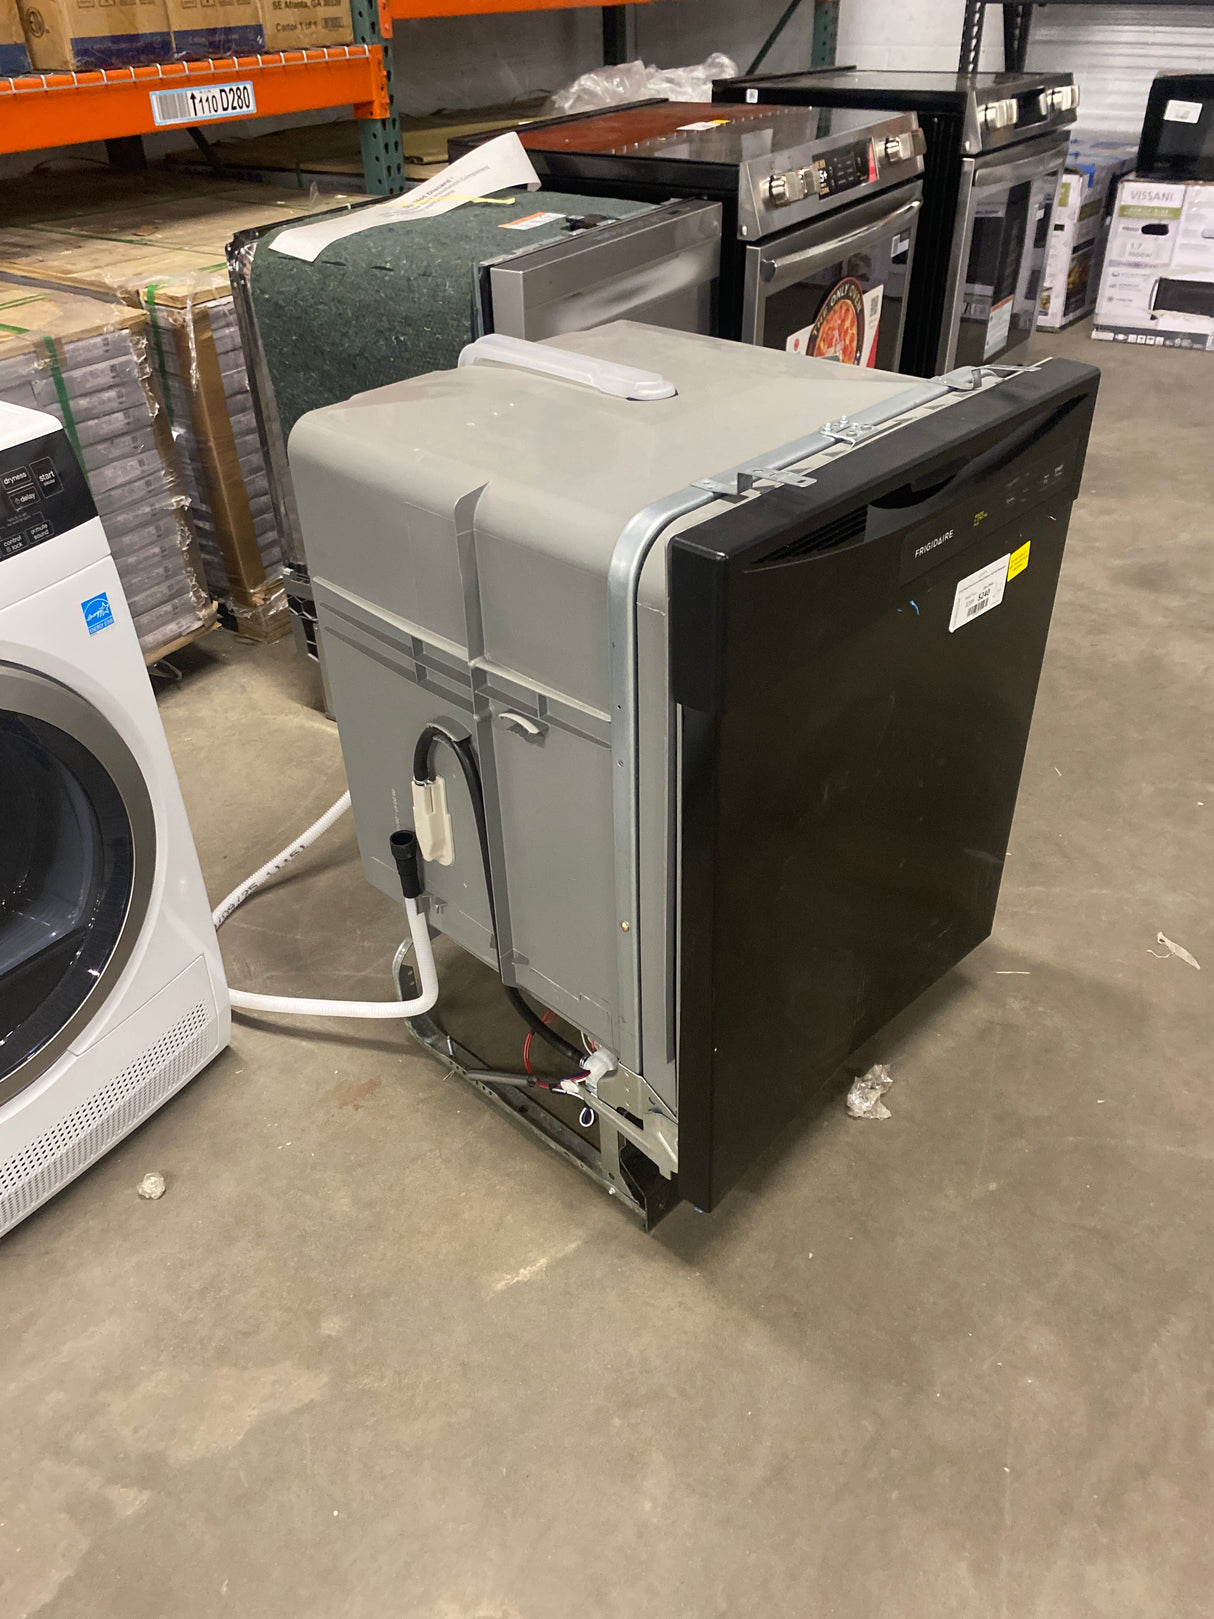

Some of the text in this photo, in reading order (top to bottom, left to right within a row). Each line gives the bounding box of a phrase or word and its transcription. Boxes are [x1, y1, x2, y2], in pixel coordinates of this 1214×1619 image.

[199, 86, 250, 115] 110 D280
[1131, 190, 1175, 202] VISSANI
[830, 283, 850, 307] ONLY
[3, 472, 27, 485] dryness
[38, 470, 56, 483] start
[20, 492, 37, 504] delay
[3, 534, 23, 547] control
[33, 529, 50, 541] sound
[11, 541, 24, 551] lock
[914, 529, 954, 558] FRIGIDAIRE
